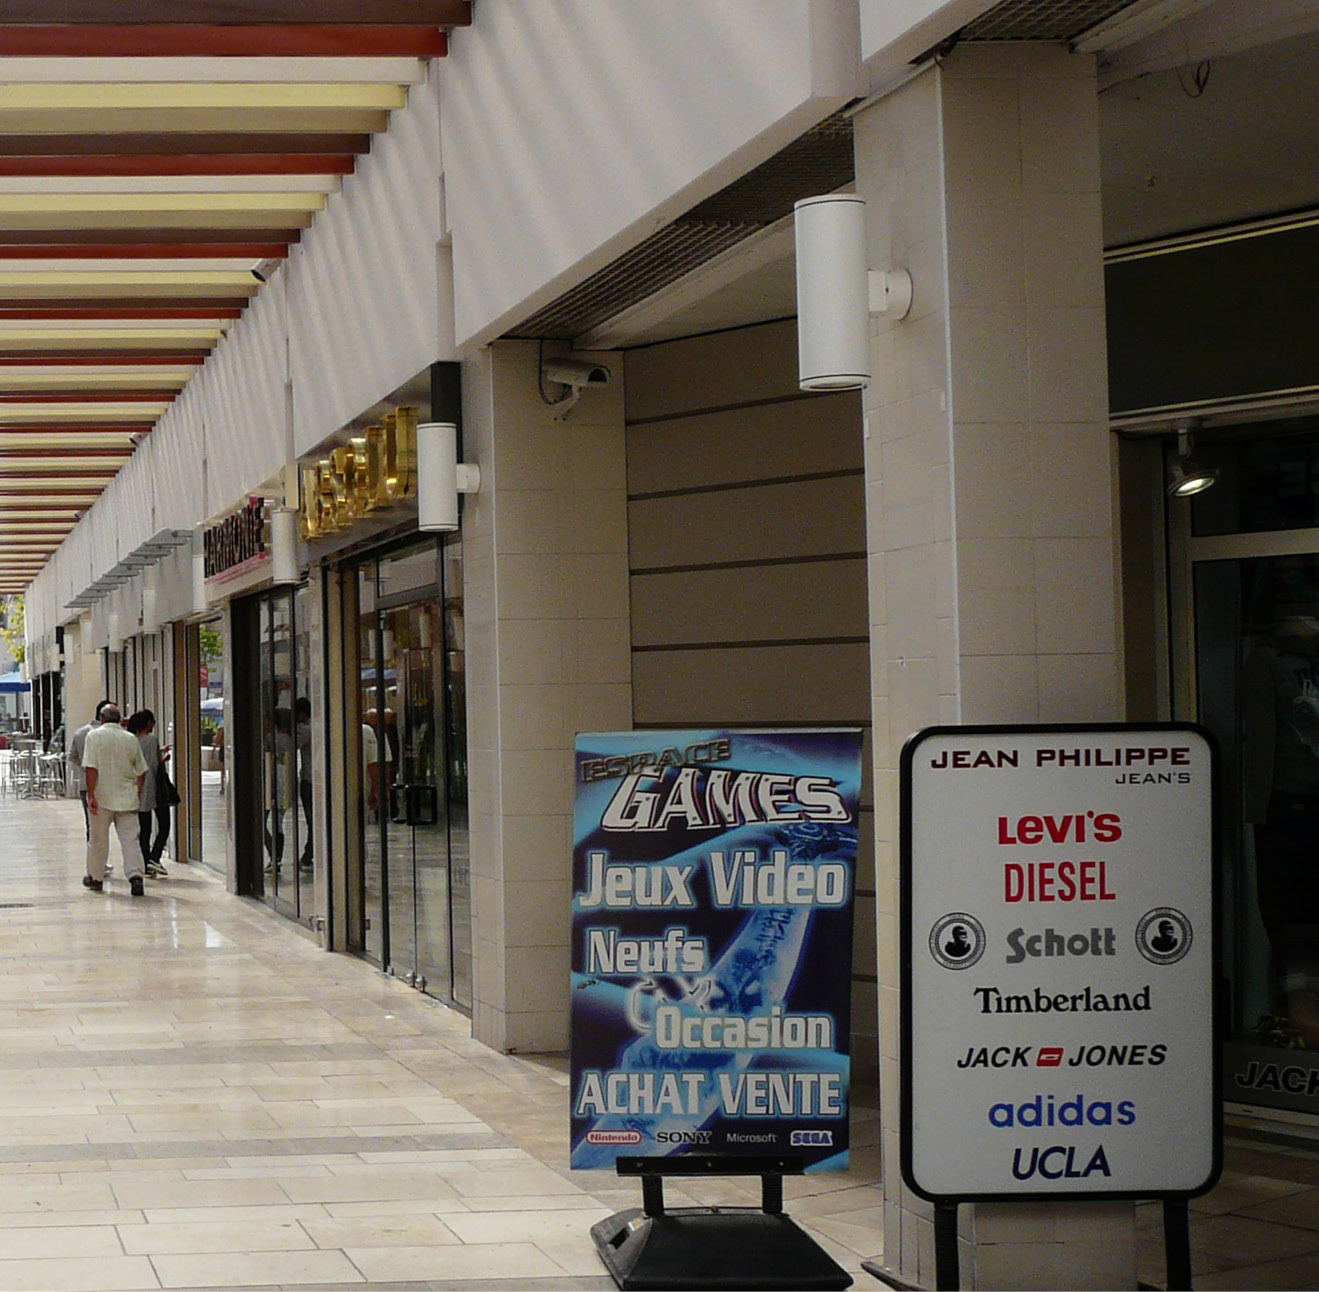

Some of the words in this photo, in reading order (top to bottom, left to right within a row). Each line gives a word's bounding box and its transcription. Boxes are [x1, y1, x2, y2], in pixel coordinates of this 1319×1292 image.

[581, 737, 733, 783] ESPACE
[930, 750, 1019, 769] JEAN
[1035, 747, 1191, 767] PHILIPPE
[1114, 772, 1191, 785] JEAN'S
[600, 766, 853, 832] GAMES
[578, 850, 694, 909] Jeux
[708, 849, 848, 909] Video
[1004, 861, 1117, 903] DIESEL
[588, 928, 706, 975] Neufs
[1005, 927, 1117, 964] Schott
[973, 985, 1152, 1014] Timberland
[655, 1004, 833, 1051] Occasion
[956, 1046, 1032, 1069] JACK
[1067, 1044, 1168, 1067] JONES
[576, 1072, 706, 1117] ACHAT
[717, 1072, 843, 1117] VENTE
[988, 1094, 1136, 1128] adidas
[587, 1131, 642, 1145] Nintendo
[656, 1131, 712, 1144] SONY
[726, 1132, 777, 1144] Microsoft
[791, 1130, 833, 1146] SEGA
[1011, 1144, 1112, 1181] UCLA
